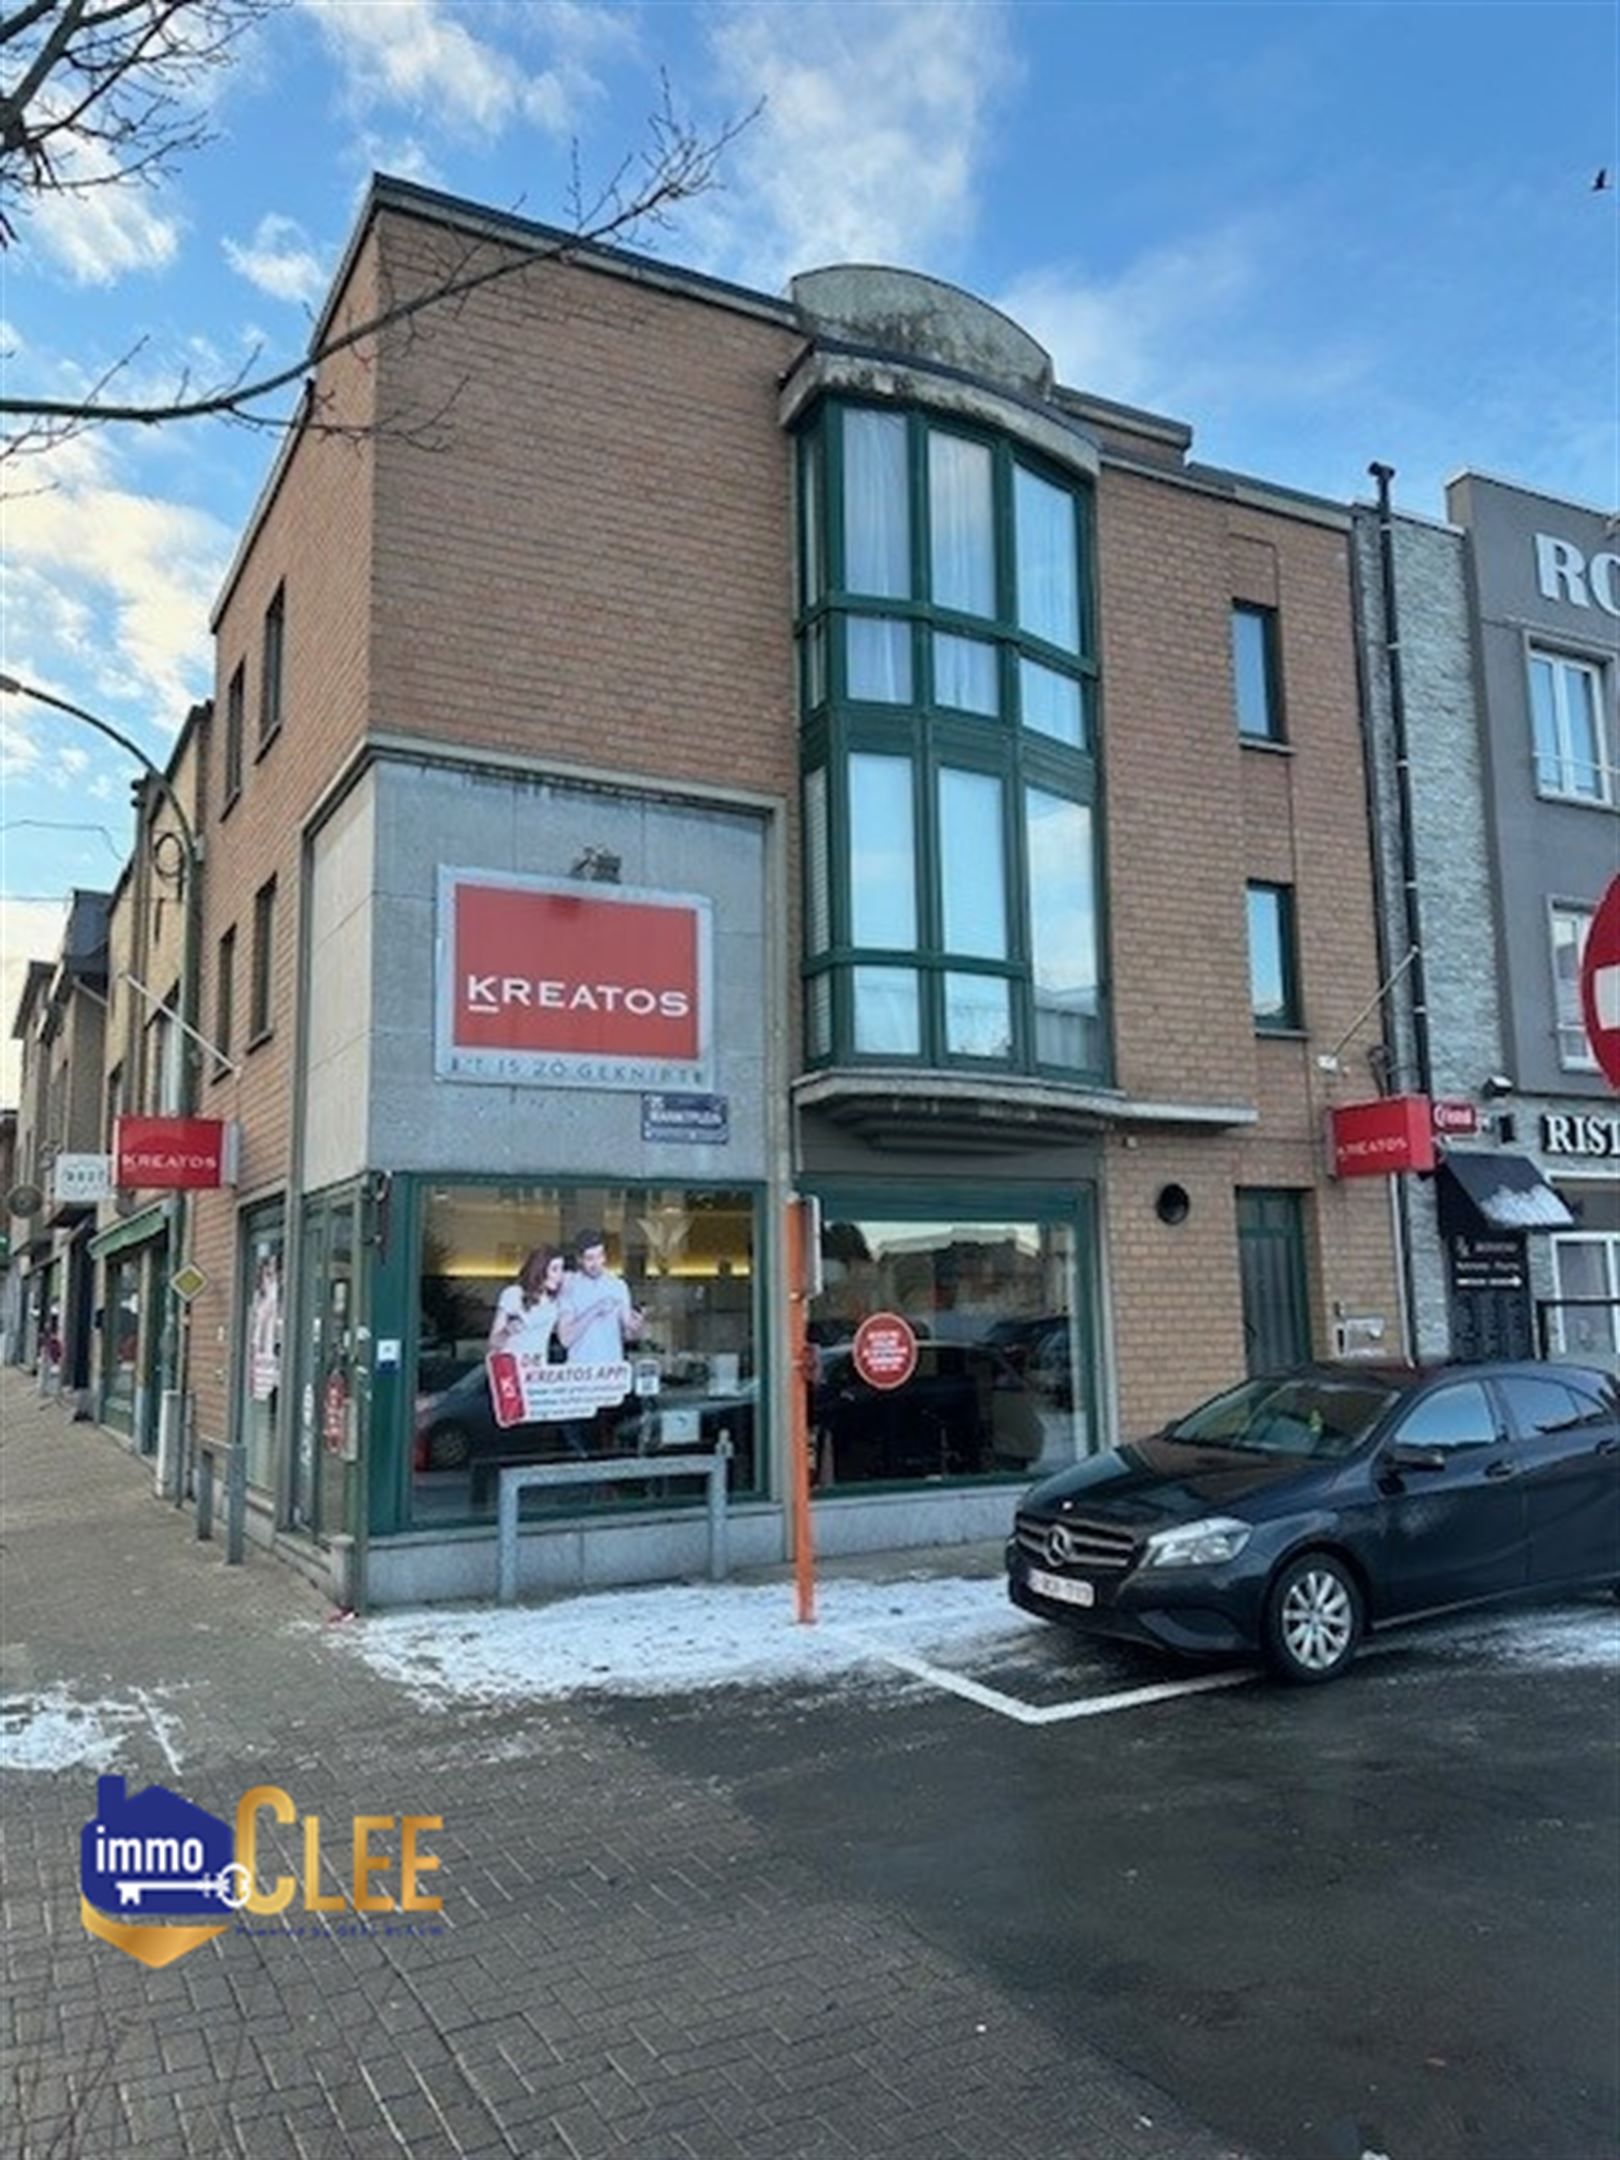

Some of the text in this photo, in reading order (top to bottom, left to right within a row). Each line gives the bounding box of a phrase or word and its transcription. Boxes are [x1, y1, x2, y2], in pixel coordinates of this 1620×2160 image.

[467, 974, 690, 1017] KREATOS
[121, 1153, 217, 1169] KREATOS
[525, 1366, 593, 1382] KREATOS
